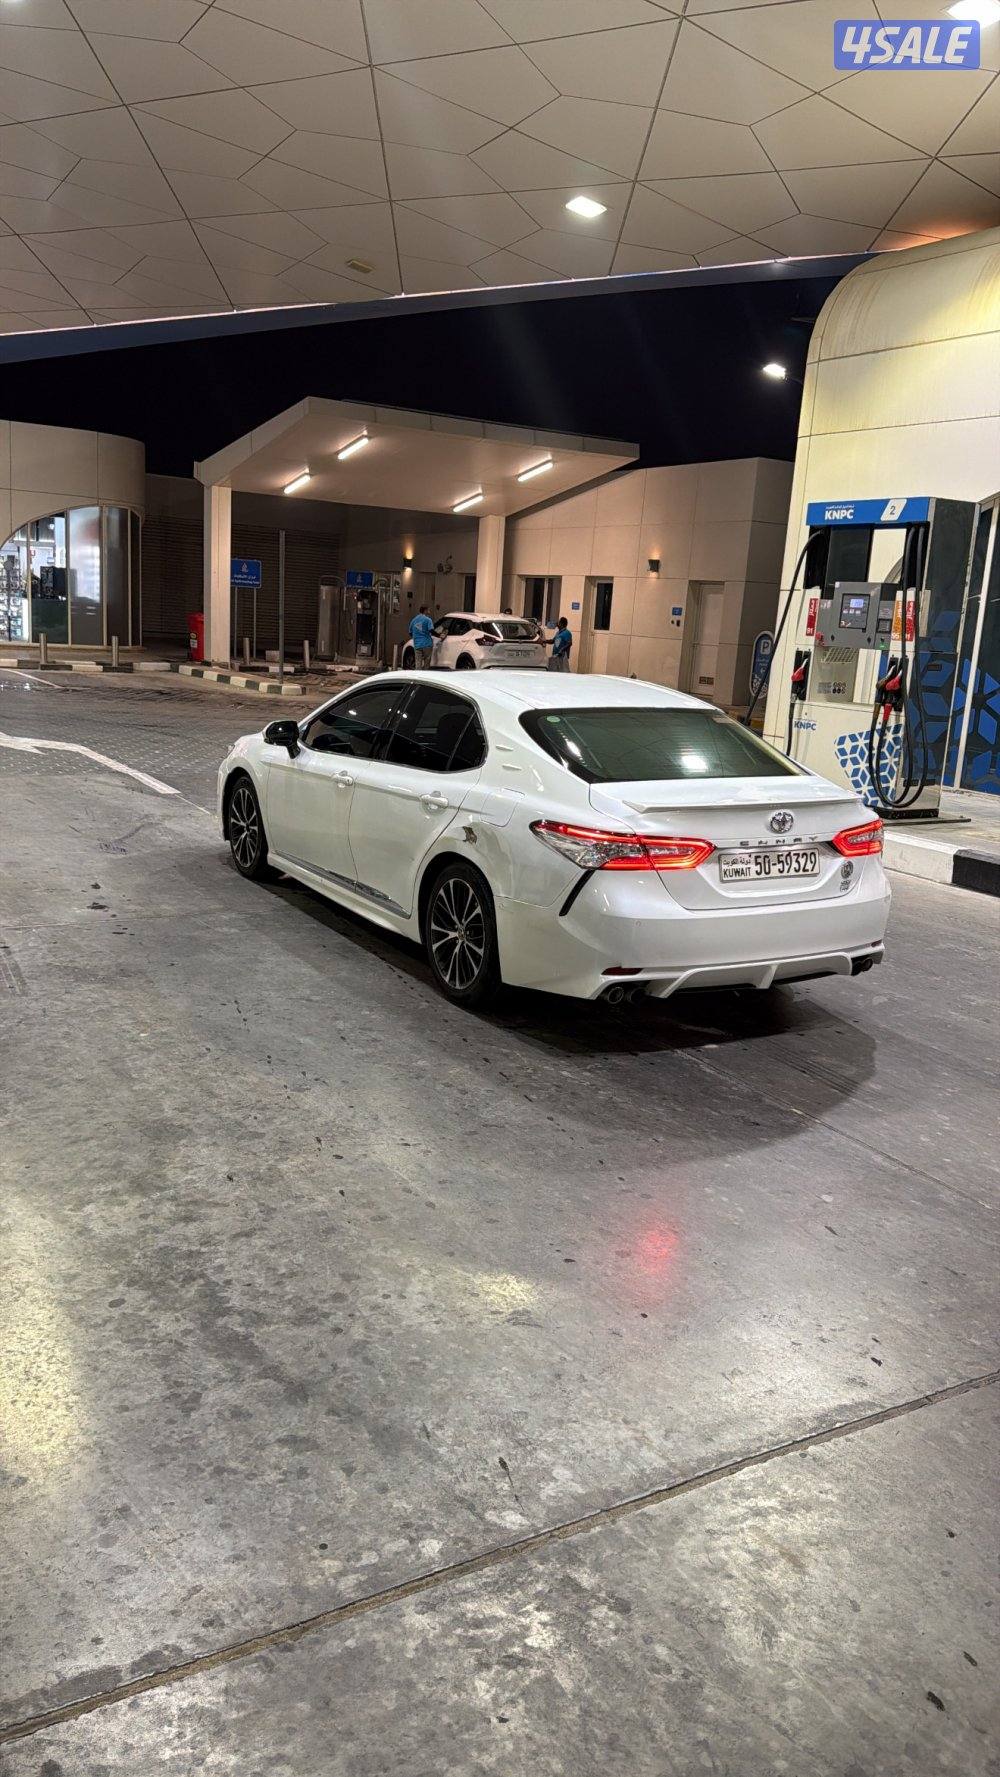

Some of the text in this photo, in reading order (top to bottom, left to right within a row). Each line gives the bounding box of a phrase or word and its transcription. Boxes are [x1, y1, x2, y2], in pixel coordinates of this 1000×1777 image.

[824, 509, 855, 521] KNPC
[889, 505, 896, 516] 2
[891, 632, 901, 640] 95
[794, 720, 817, 731] KNPC
[754, 851, 817, 876] 50-59329
[723, 866, 751, 879] KUWAIT
